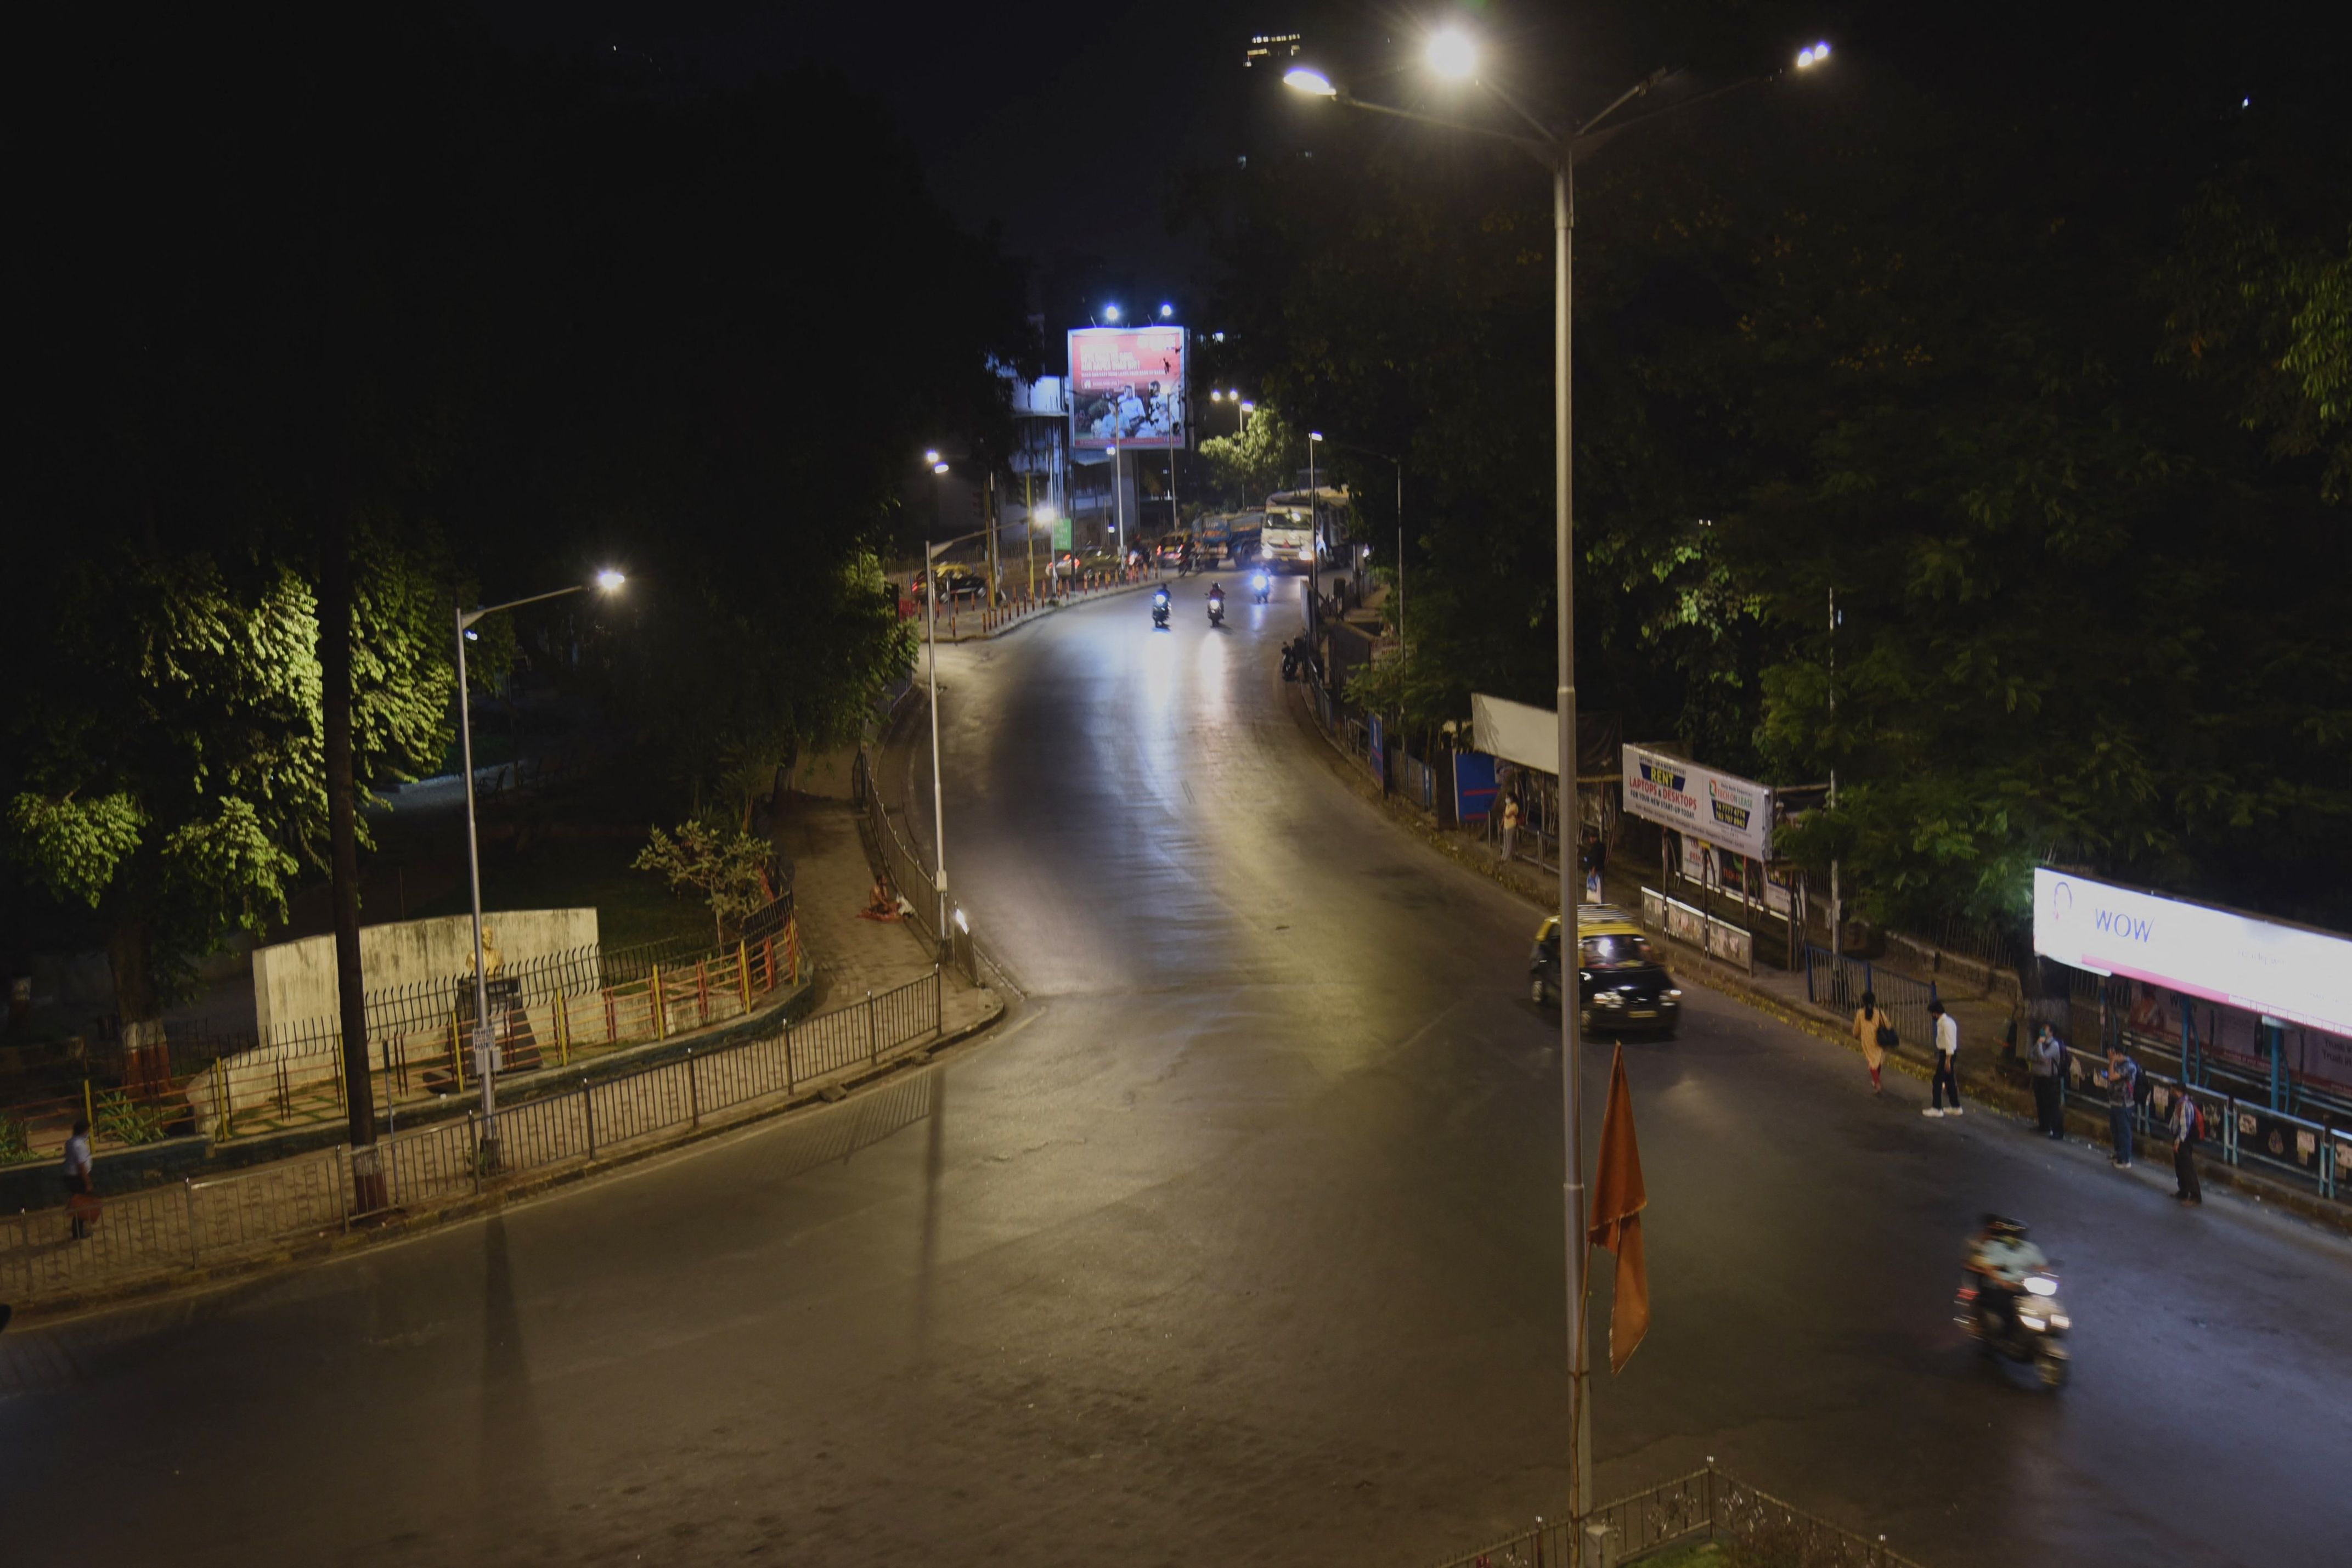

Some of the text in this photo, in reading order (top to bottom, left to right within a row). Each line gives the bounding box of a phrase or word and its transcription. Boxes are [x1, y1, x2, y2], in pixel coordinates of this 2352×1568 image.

[1651, 767, 1674, 788] RENT
[1629, 776, 1657, 797] LAPTOPS
[1663, 787, 1697, 811] DESKTOPS
[1639, 792, 1650, 804] YOUR
[1650, 796, 1660, 806] NEW
[1661, 800, 1680, 814] START-UP
[2095, 907, 2155, 944] WOW
